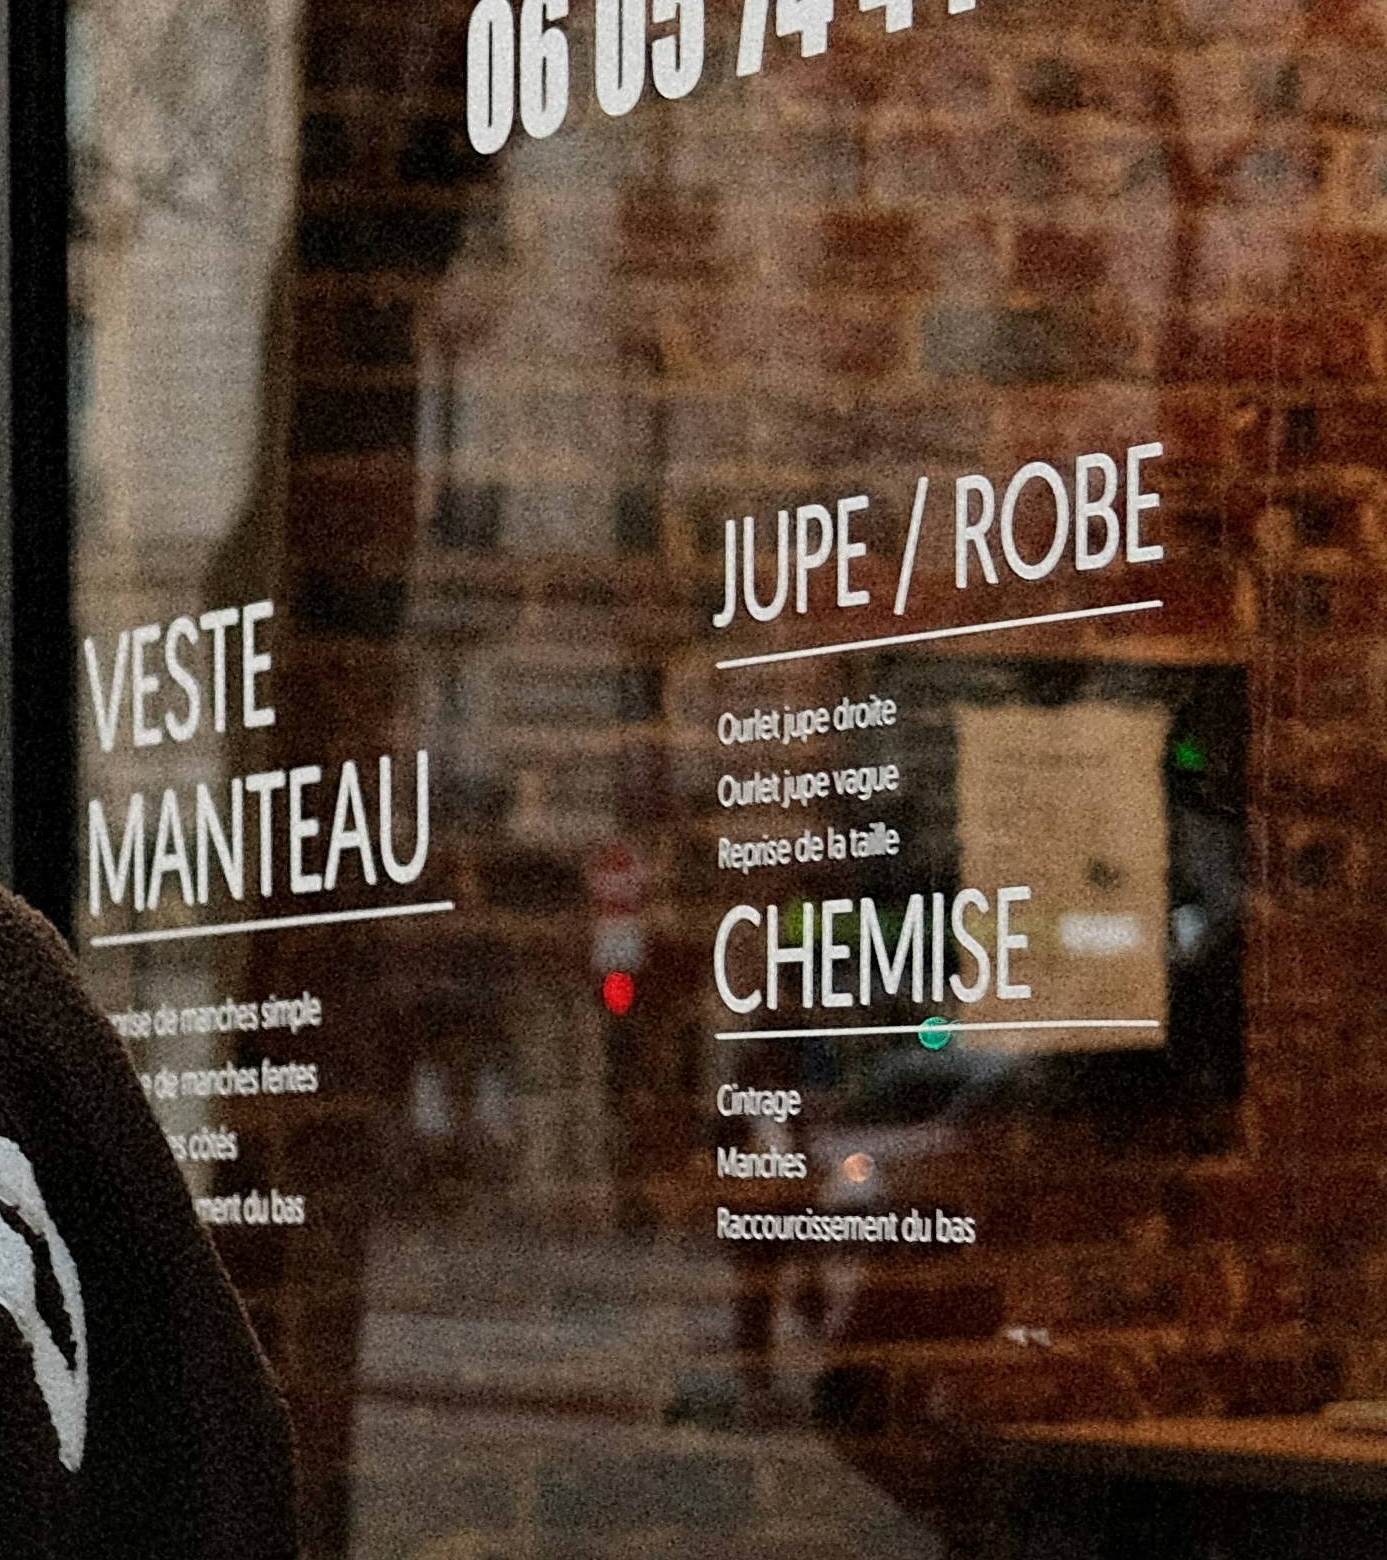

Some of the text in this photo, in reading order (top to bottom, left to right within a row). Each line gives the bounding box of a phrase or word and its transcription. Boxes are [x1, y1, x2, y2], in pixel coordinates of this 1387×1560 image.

[712, 441, 1164, 629] JUPE / ROBE
[83, 598, 276, 752] VESTE
[717, 694, 897, 745] Ourlet jupe droite
[717, 763, 900, 809] Ourlet jupe vague
[88, 749, 430, 918] MANTEAU
[717, 821, 901, 876] Reprise de la taille
[713, 885, 1032, 1014] CHEMISE
[261, 990, 322, 1035] simple
[716, 1083, 802, 1123] Cintrage
[716, 1144, 807, 1180] Manches
[243, 1188, 270, 1226] du
[271, 1187, 307, 1226] bas
[716, 1206, 977, 1245] Raccourcissement du bas
